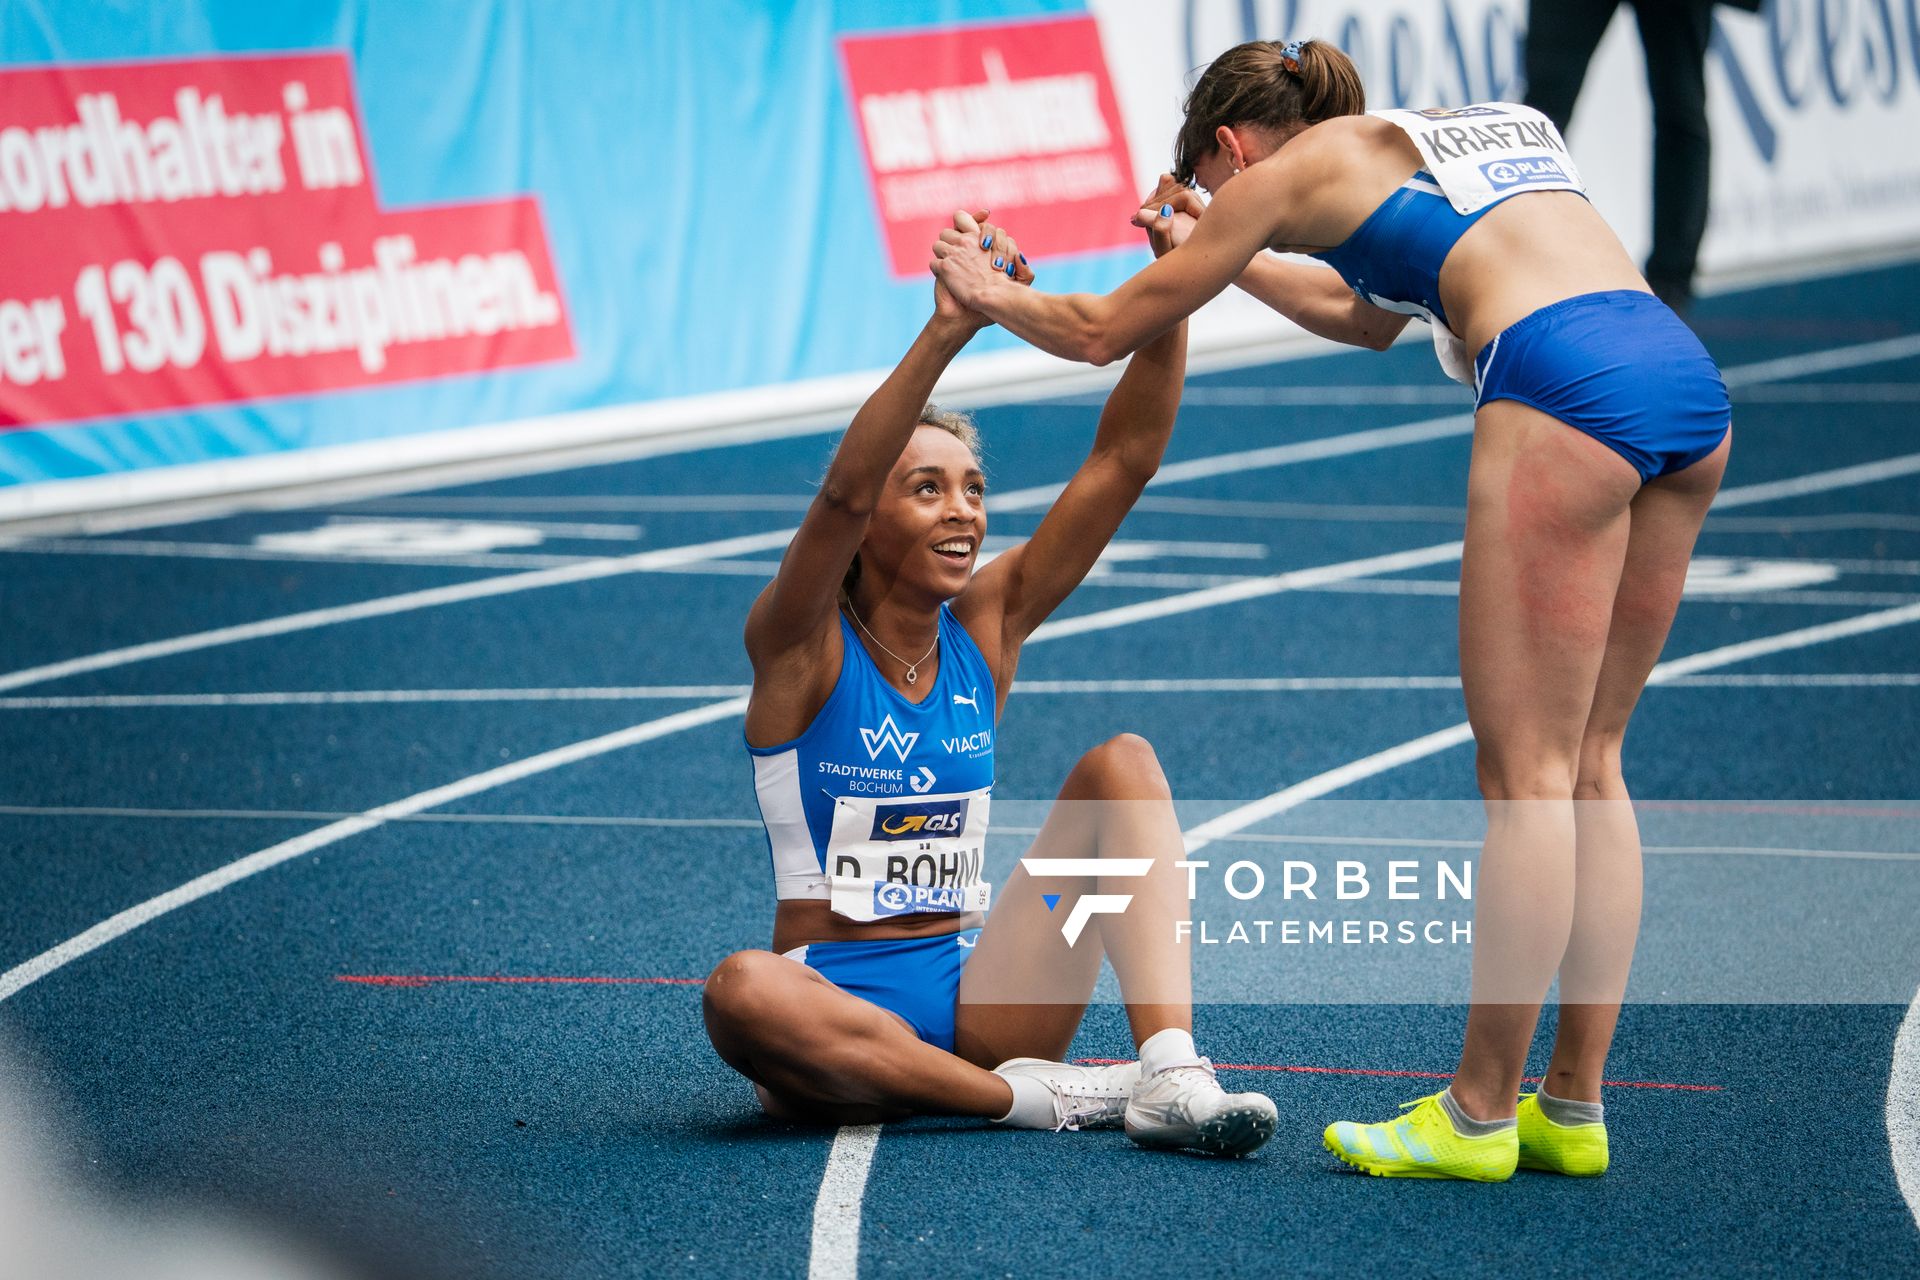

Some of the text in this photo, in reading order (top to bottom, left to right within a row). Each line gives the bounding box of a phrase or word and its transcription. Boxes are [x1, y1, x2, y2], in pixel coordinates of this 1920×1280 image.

[0, 81, 362, 211] ordhalter in
[1420, 121, 1563, 164] KRAFZIK
[1516, 161, 1562, 175] PLAN
[0, 234, 559, 385] er 130 Disziplinen.
[941, 728, 991, 754] VIACTIV
[819, 762, 903, 780] STADTWERKE
[849, 781, 903, 794] BOCHUM
[924, 812, 960, 832] GLS
[887, 843, 979, 888] BÖHM
[915, 887, 962, 909] PLAN
